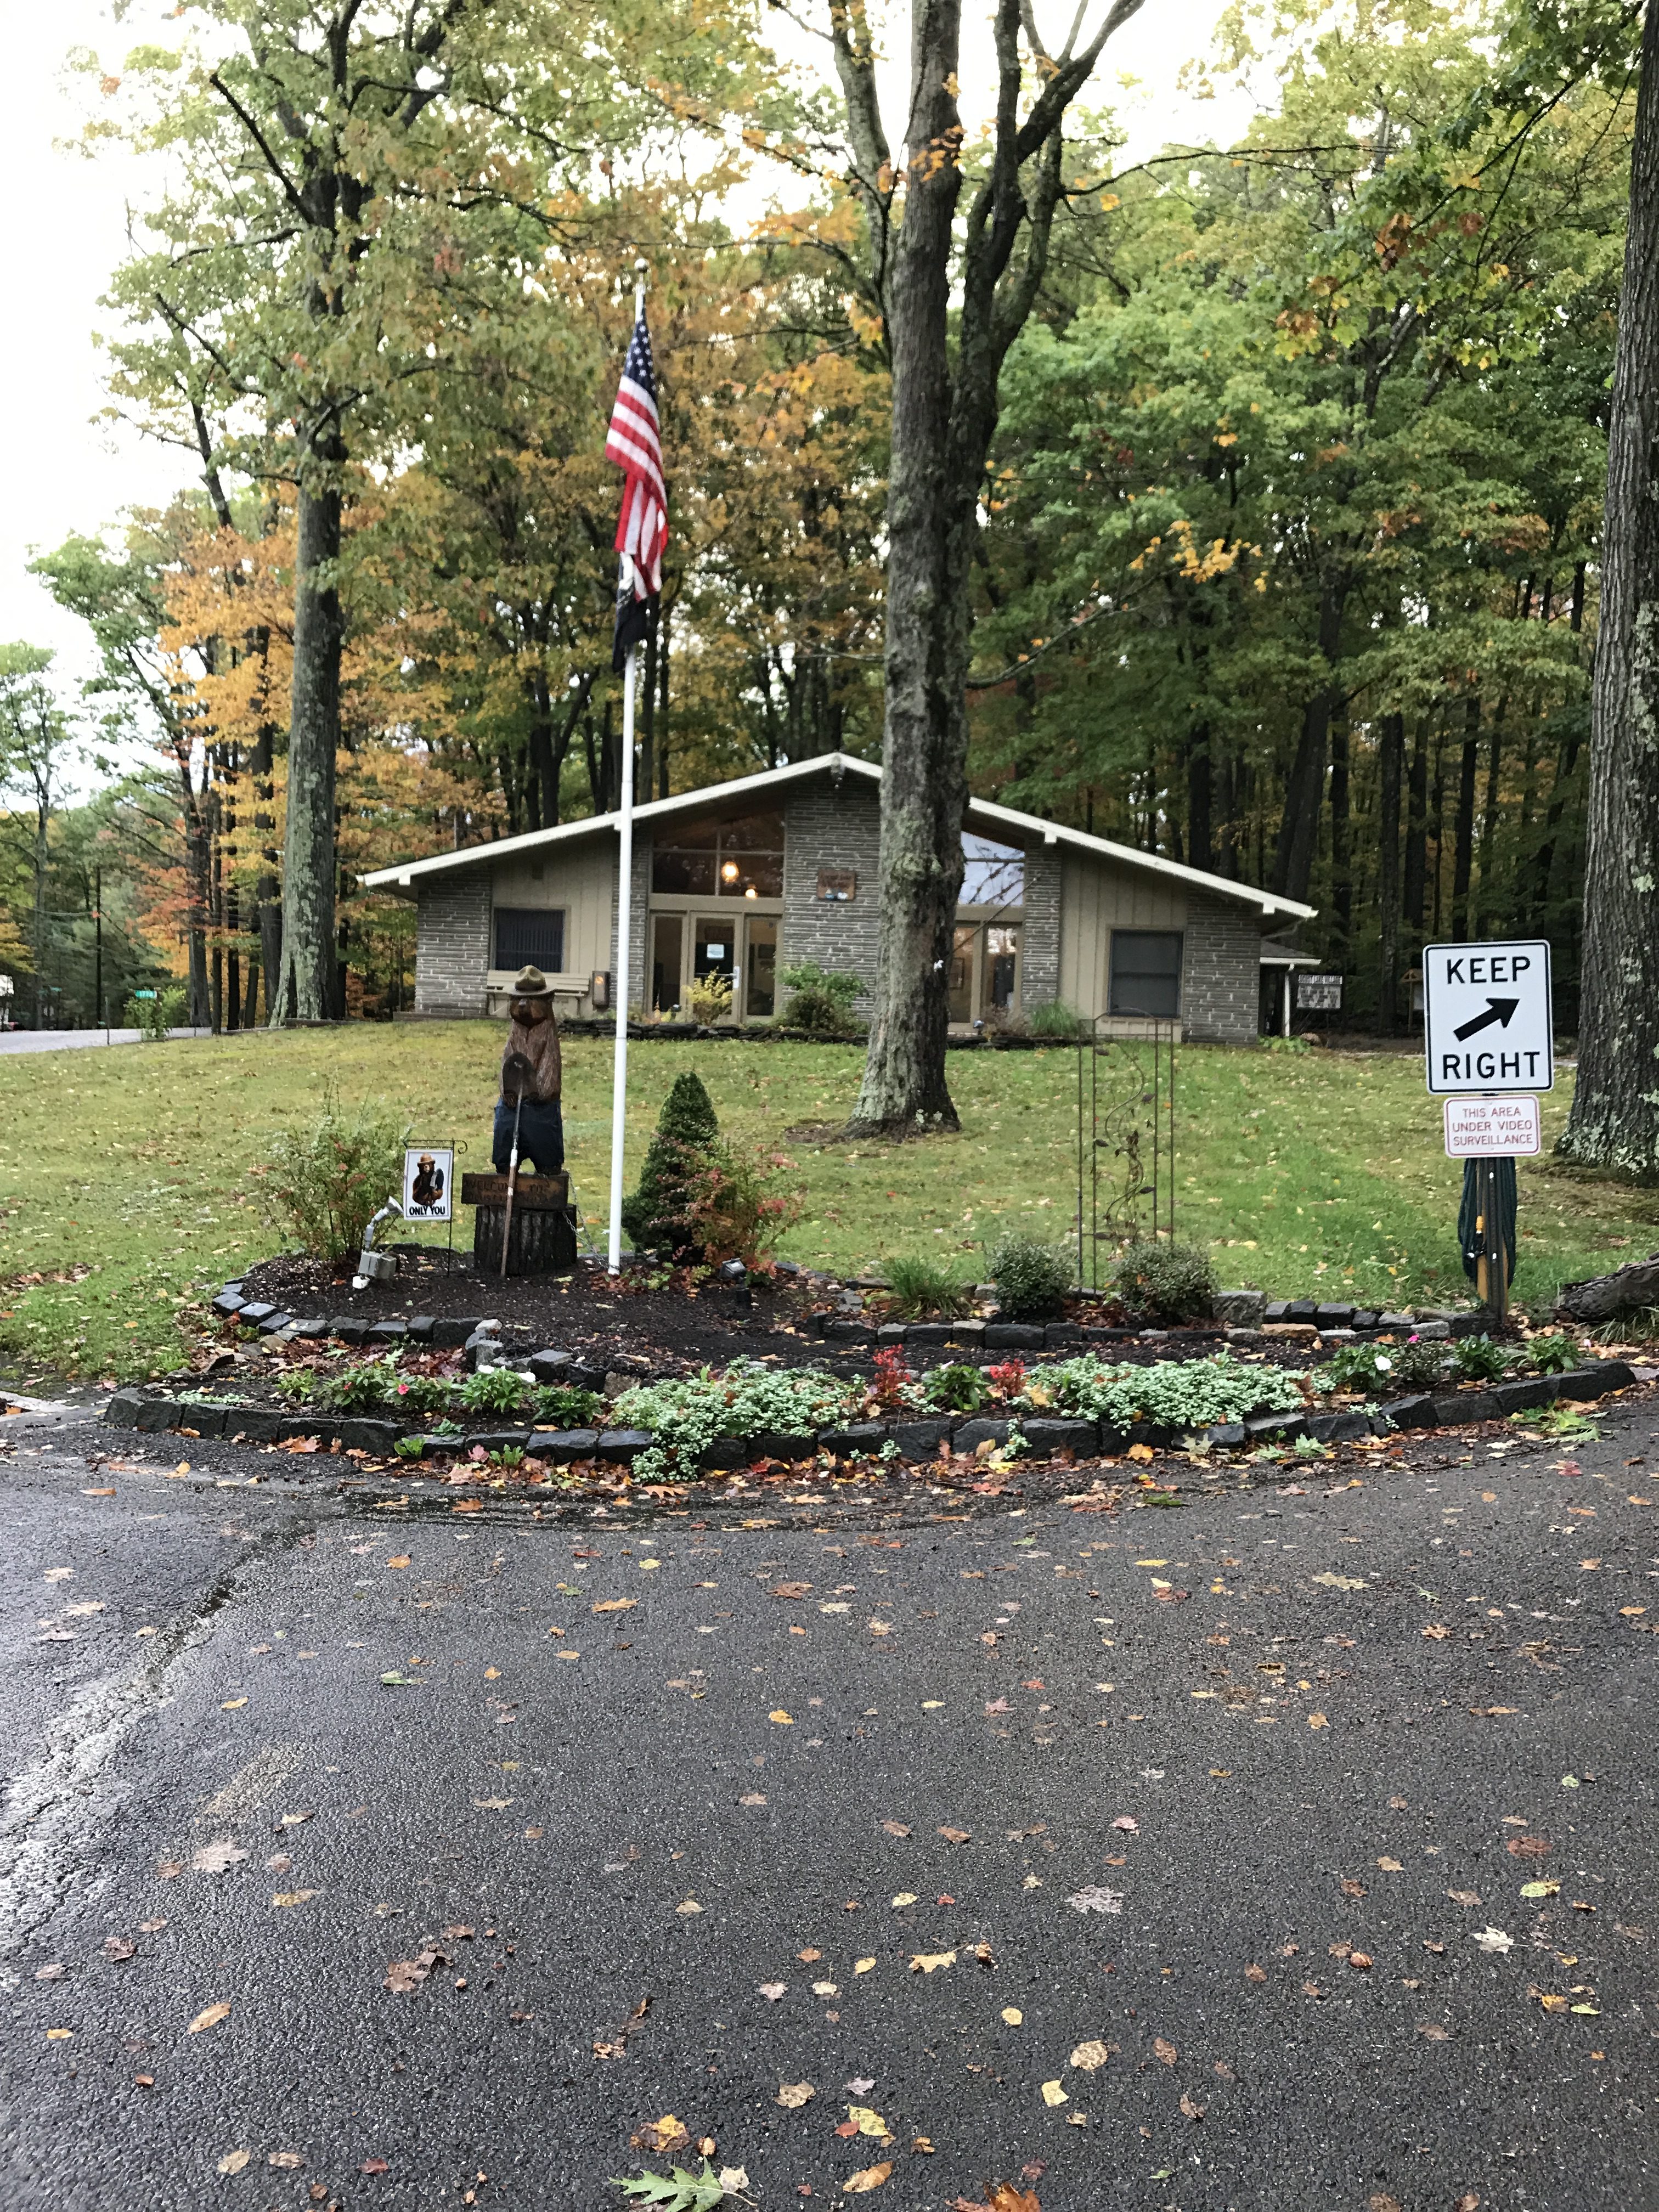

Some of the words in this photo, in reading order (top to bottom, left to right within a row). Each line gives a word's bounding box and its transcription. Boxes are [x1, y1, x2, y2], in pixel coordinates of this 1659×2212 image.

[1447, 956, 1531, 984] KEEP
[1443, 1051, 1541, 1080] RIGHT
[1463, 1108, 1486, 1118] THIS
[1491, 1106, 1521, 1117] AREA
[1452, 1121, 1492, 1132] UNDER
[1498, 1120, 1533, 1131] VIDEO
[1453, 1133, 1533, 1146] SURVEILLANCE
[409, 1205, 428, 1216] ONLY
[430, 1206, 445, 1215] YOU
